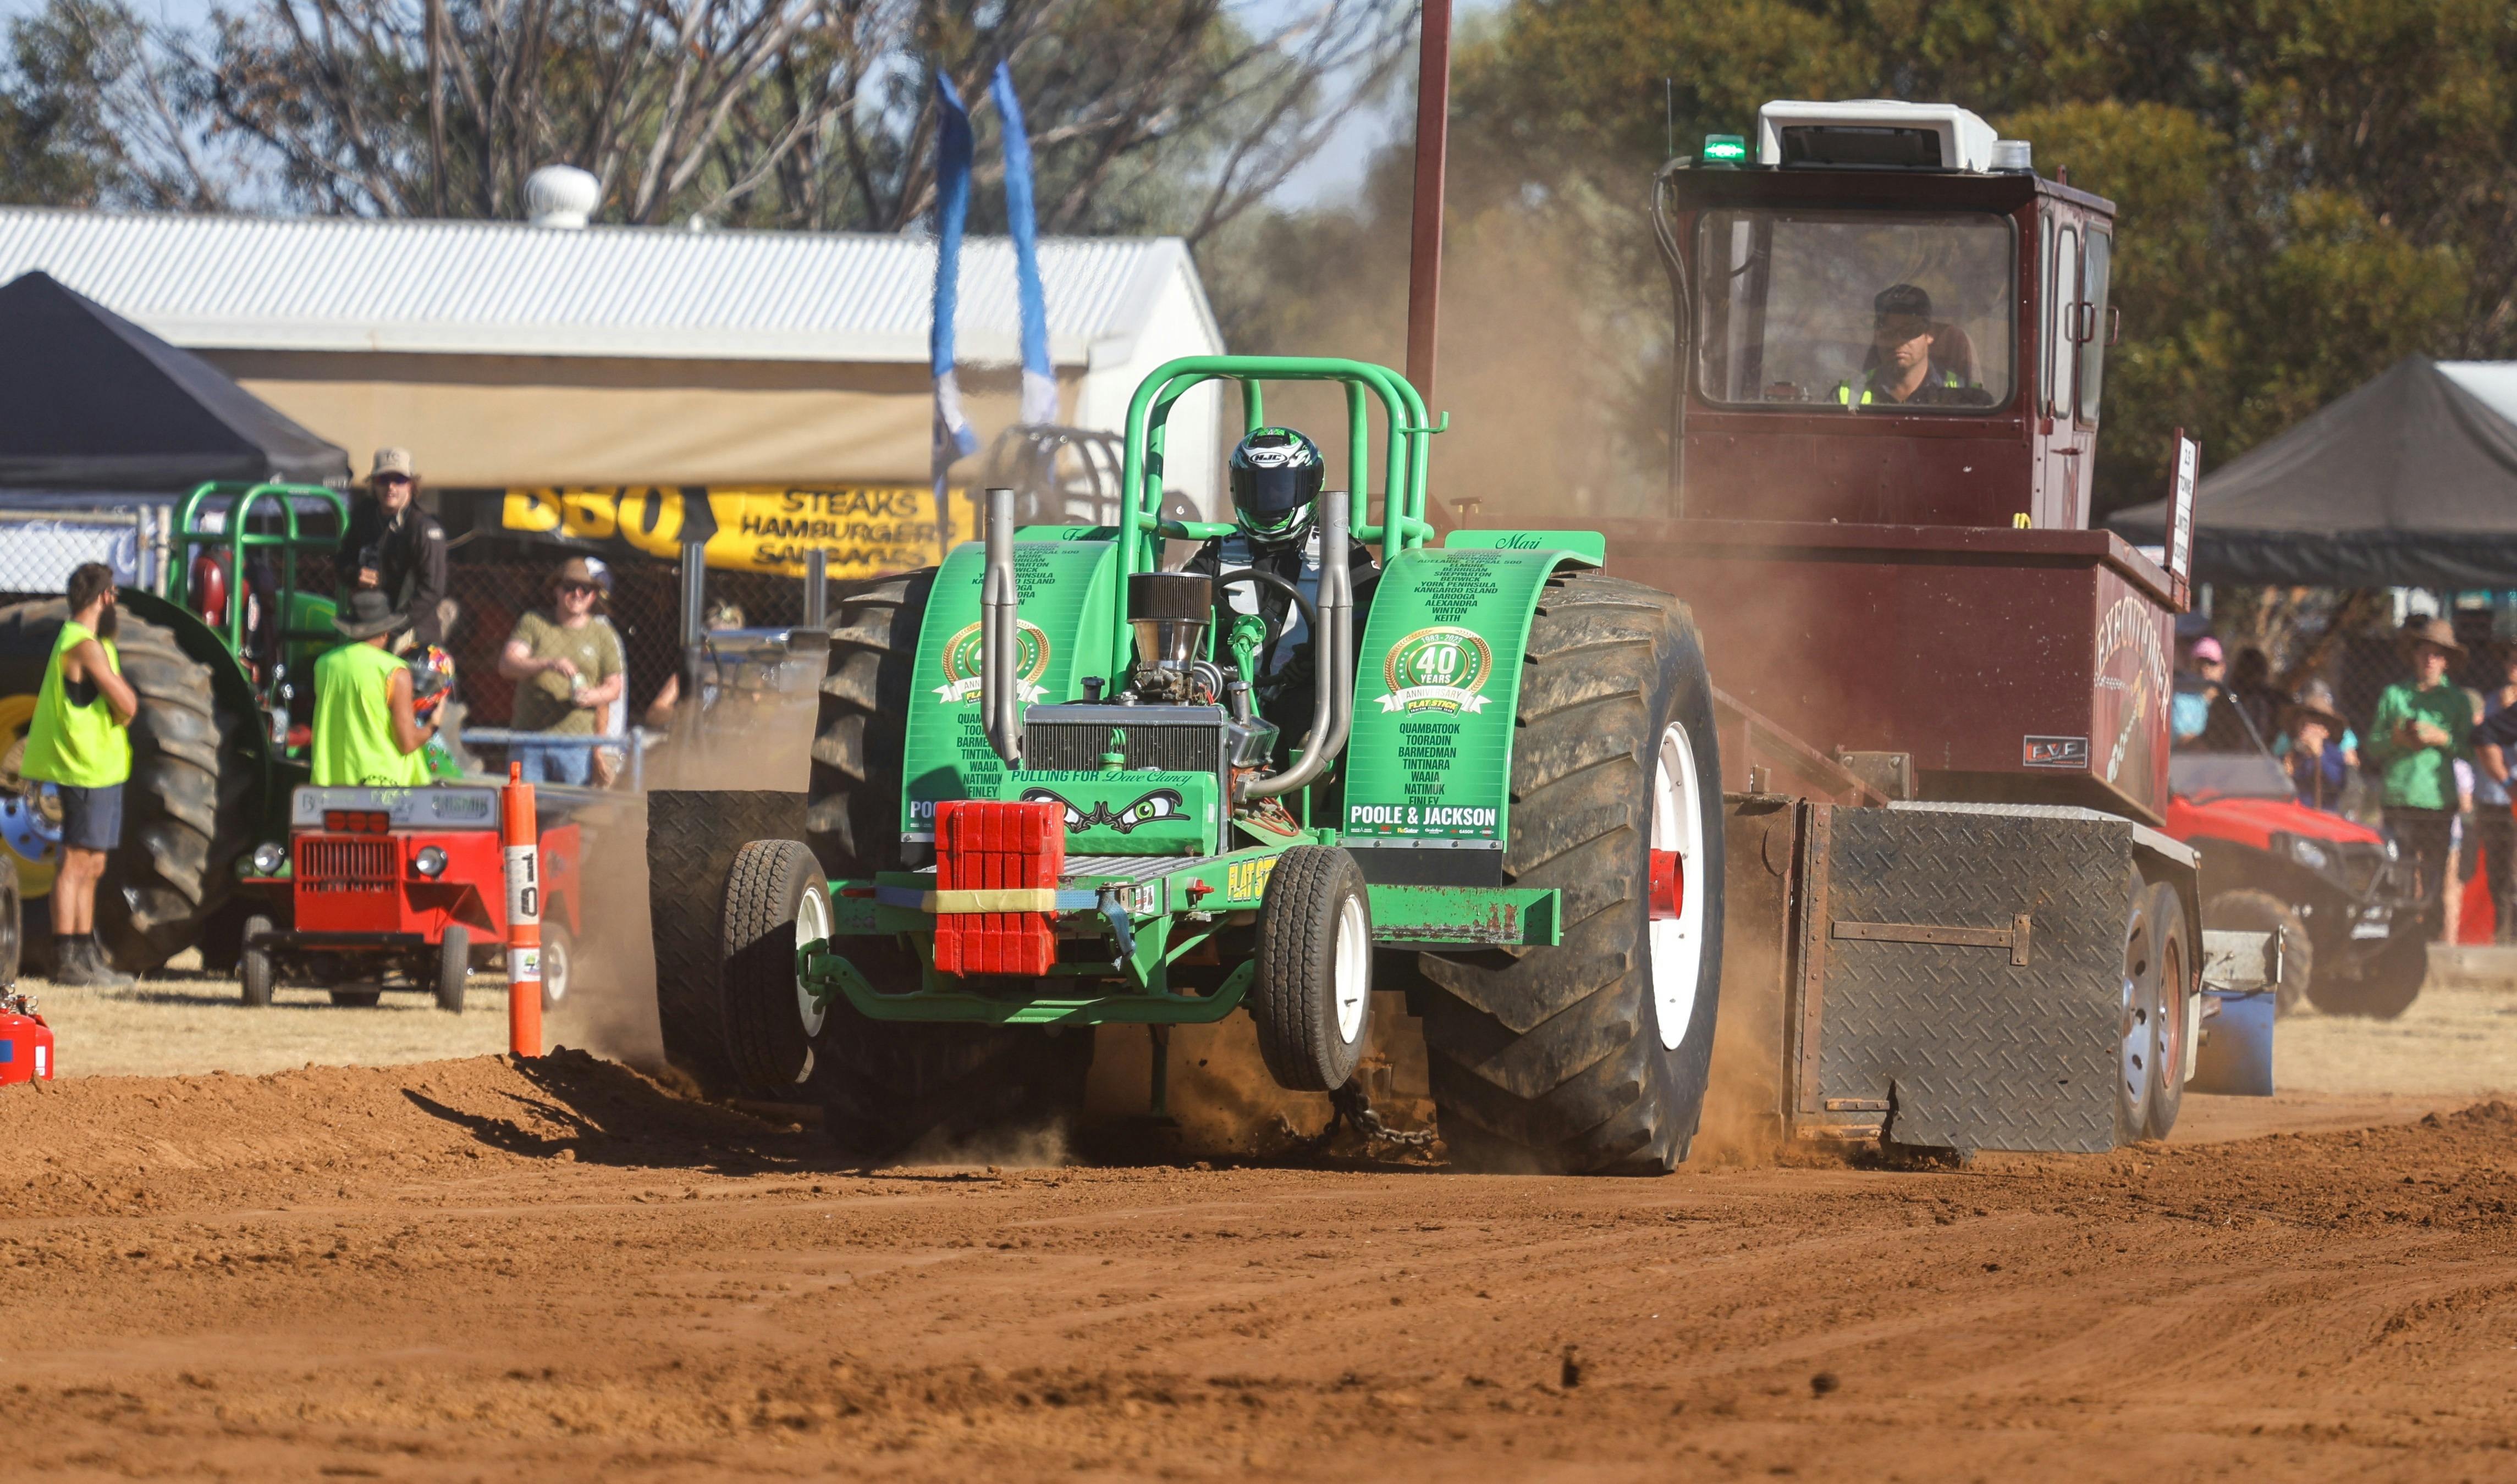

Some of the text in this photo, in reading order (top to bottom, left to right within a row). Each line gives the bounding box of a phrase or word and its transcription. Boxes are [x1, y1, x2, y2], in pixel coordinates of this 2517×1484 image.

[781, 489, 918, 517] STEAKS
[1421, 635, 1439, 643] 1983
[1444, 634, 1463, 643] 2023
[1416, 647, 1457, 674] 40
[1420, 674, 1451, 684] YEARS
[1406, 688, 1462, 699] ANNIVERSARY
[1408, 699, 1458, 710] FLAT STICK
[1399, 723, 1461, 735] QUAMBATOOK
[1406, 735, 1451, 746] TOORADIN
[1398, 747, 1457, 758] BARMEDMAN
[970, 762, 998, 772] WAAIA
[1403, 759, 1450, 770] TINTINARA
[1011, 770, 1192, 786] PULLING FOR Dave Clancy
[1411, 771, 1440, 782] WAAIA
[968, 786, 998, 797] FINLEY
[1404, 784, 1445, 795] NATIMUK
[1409, 796, 1439, 805] FINLEY
[1351, 806, 1496, 826] POOLE & JACKSON
[1227, 858, 1255, 903] FLAT
